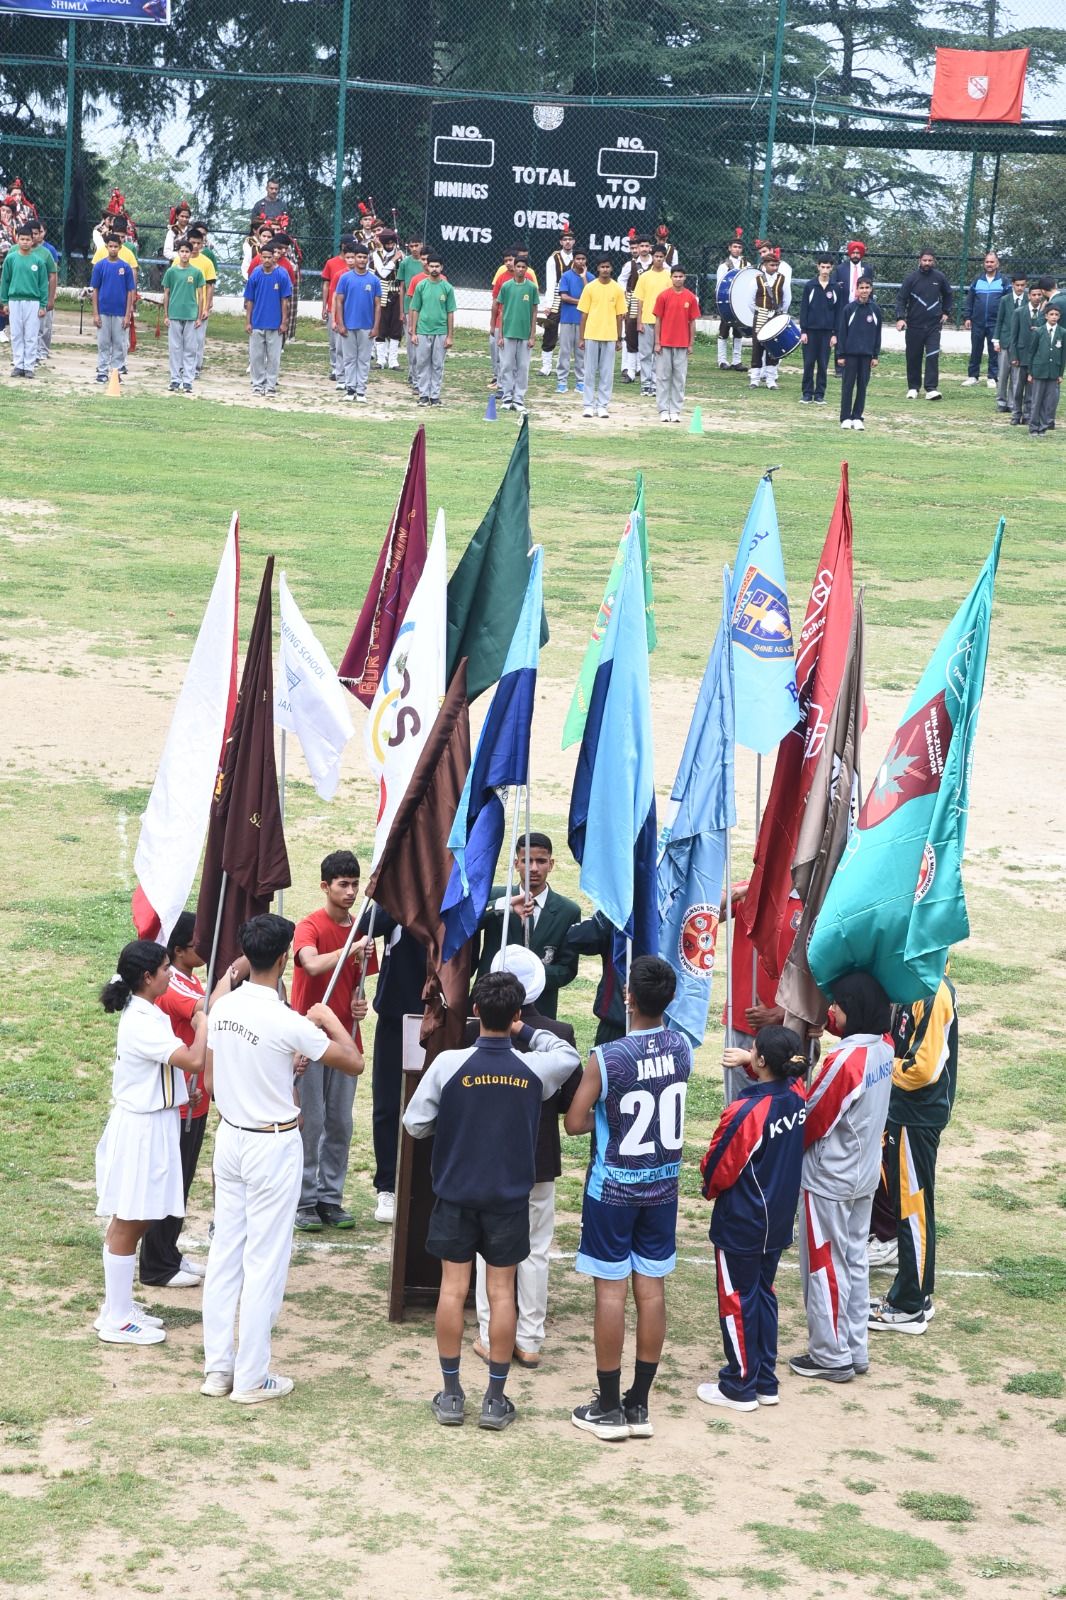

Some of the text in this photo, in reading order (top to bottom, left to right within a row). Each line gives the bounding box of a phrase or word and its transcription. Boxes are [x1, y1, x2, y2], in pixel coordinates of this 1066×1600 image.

[51, 1, 89, 11] SHIMLA
[451, 125, 482, 138] NO.
[616, 137, 644, 150] NO.
[512, 166, 576, 187] TOTAL
[434, 181, 489, 199] INNINGS
[606, 179, 641, 194] TO
[596, 194, 647, 211] WIN
[513, 210, 570, 230] OVERS
[441, 225, 493, 243] WKTS
[589, 234, 631, 252] LMS
[752, 643, 773, 653] SHINE
[297, 646, 326, 679] SCHOOL
[924, 720, 938, 776] ILAN-NOOR
[636, 1053, 676, 1081] JAIN
[461, 1074, 529, 1089] Cottonian
[618, 1081, 688, 1157] 20
[769, 1108, 806, 1139] KVS
